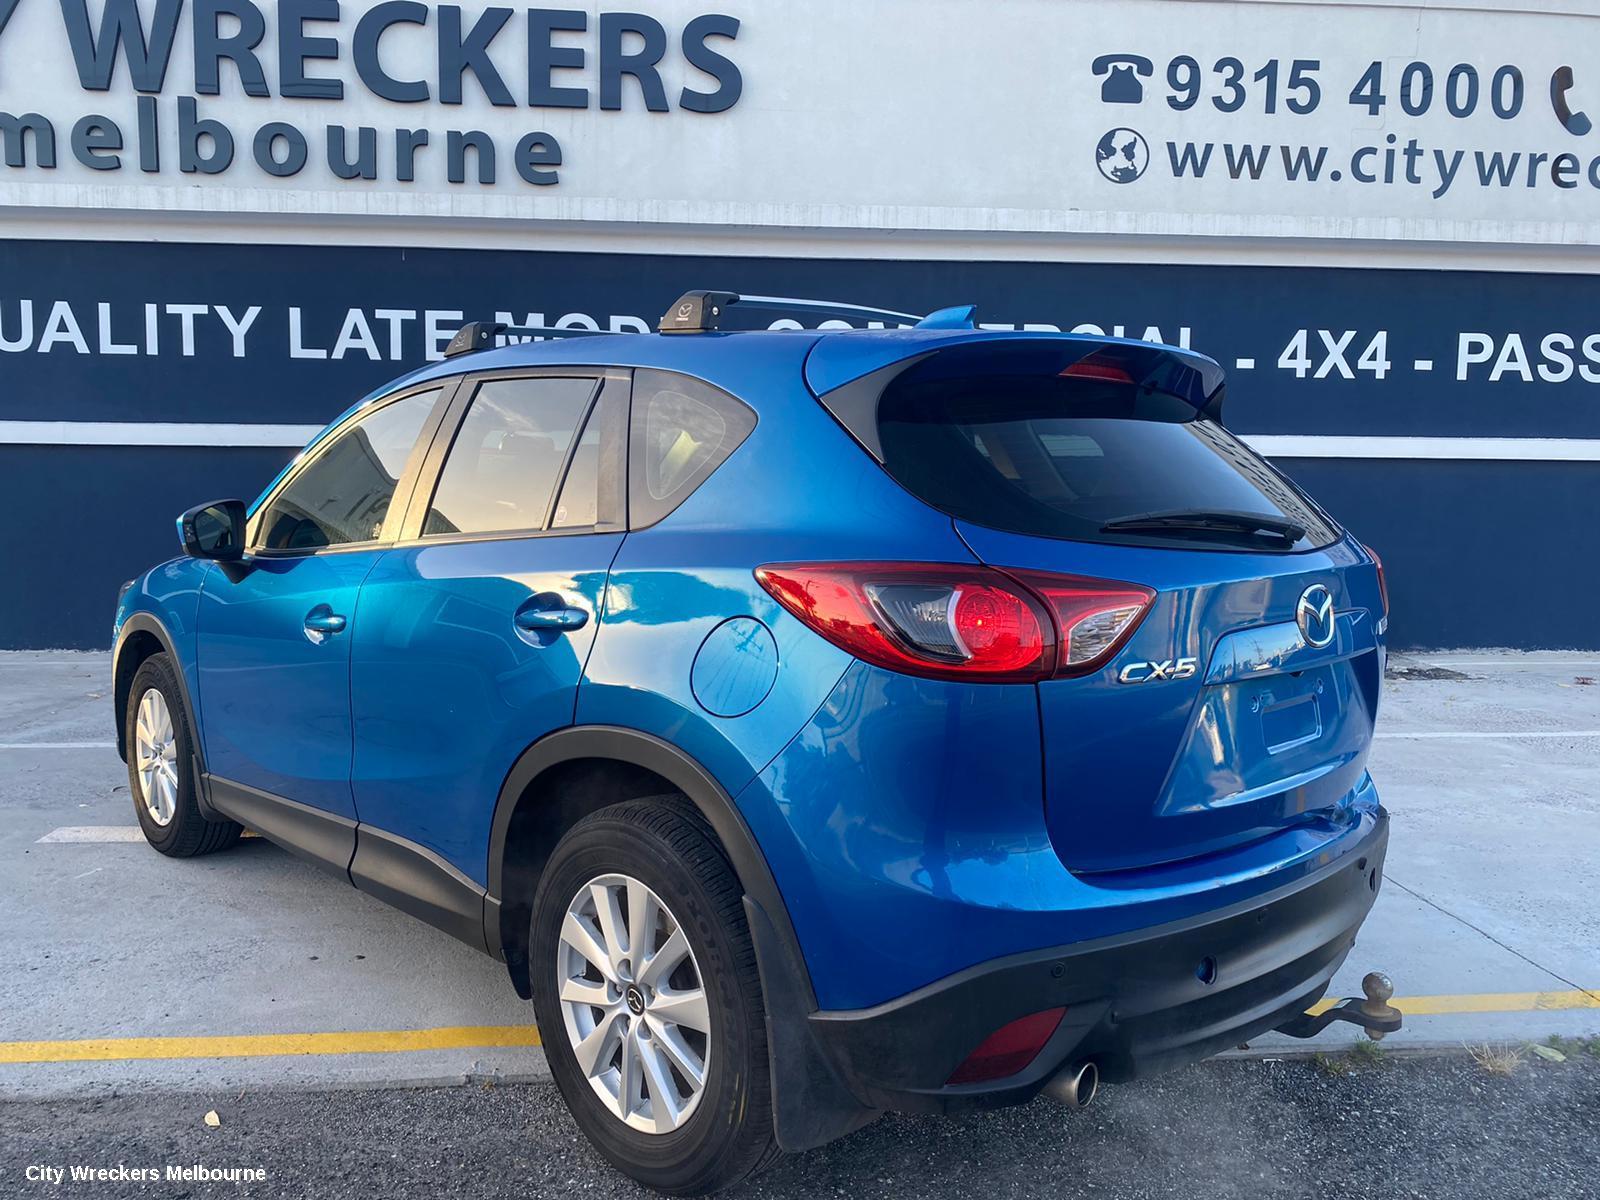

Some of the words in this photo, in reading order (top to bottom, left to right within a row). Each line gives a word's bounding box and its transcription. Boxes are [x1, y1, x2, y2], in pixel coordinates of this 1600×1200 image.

[59, 0, 743, 114] WRECKERS
[1166, 55, 1322, 115] 9315
[1349, 61, 1524, 120] 4000
[0, 95, 563, 186] melbourne
[0, 299, 262, 357] UALITY
[288, 306, 463, 361] LATE
[1277, 329, 1391, 380] 4X4
[1119, 657, 1197, 683] CX-5
